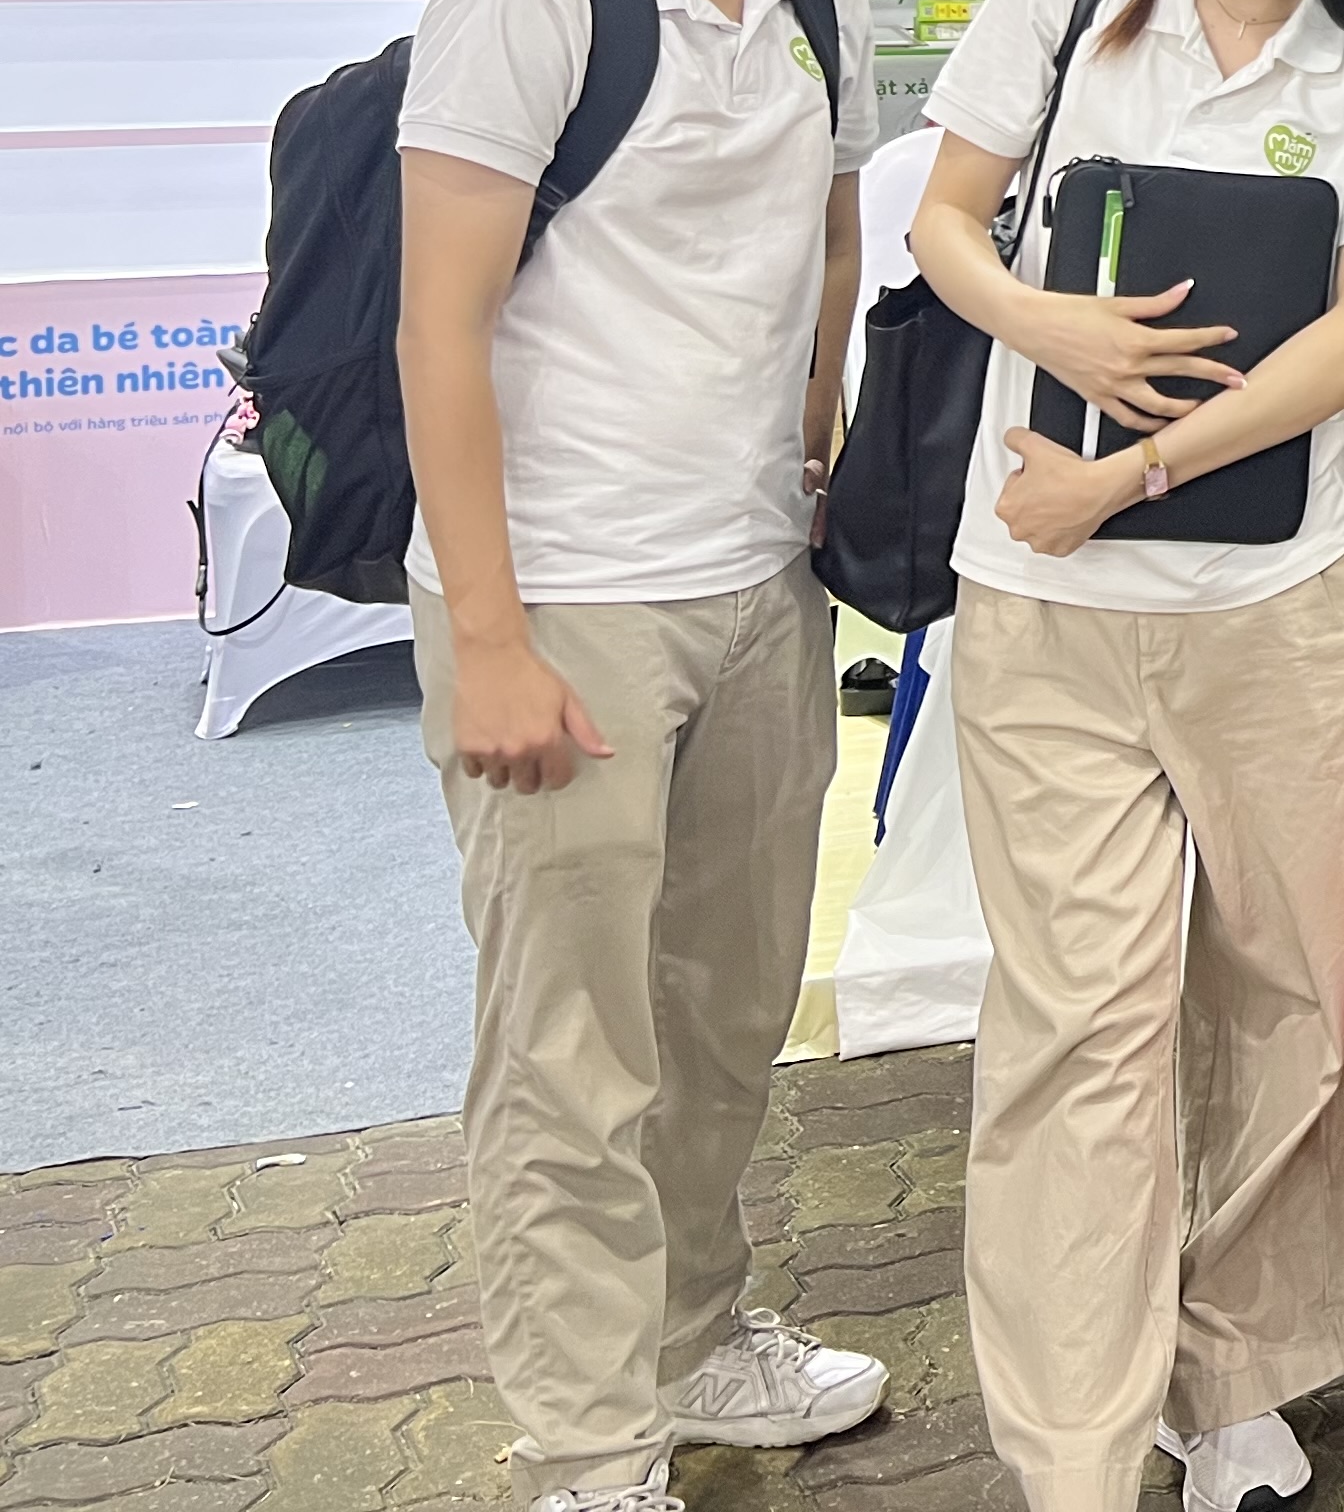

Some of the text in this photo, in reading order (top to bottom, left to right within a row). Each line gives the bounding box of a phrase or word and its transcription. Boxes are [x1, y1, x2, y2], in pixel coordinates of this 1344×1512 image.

[905, 77, 928, 95] xả
[1268, 133, 1313, 158] Măm
[30, 326, 79, 355] da
[92, 321, 139, 352] bé
[0, 361, 224, 400] thiên nhiên
